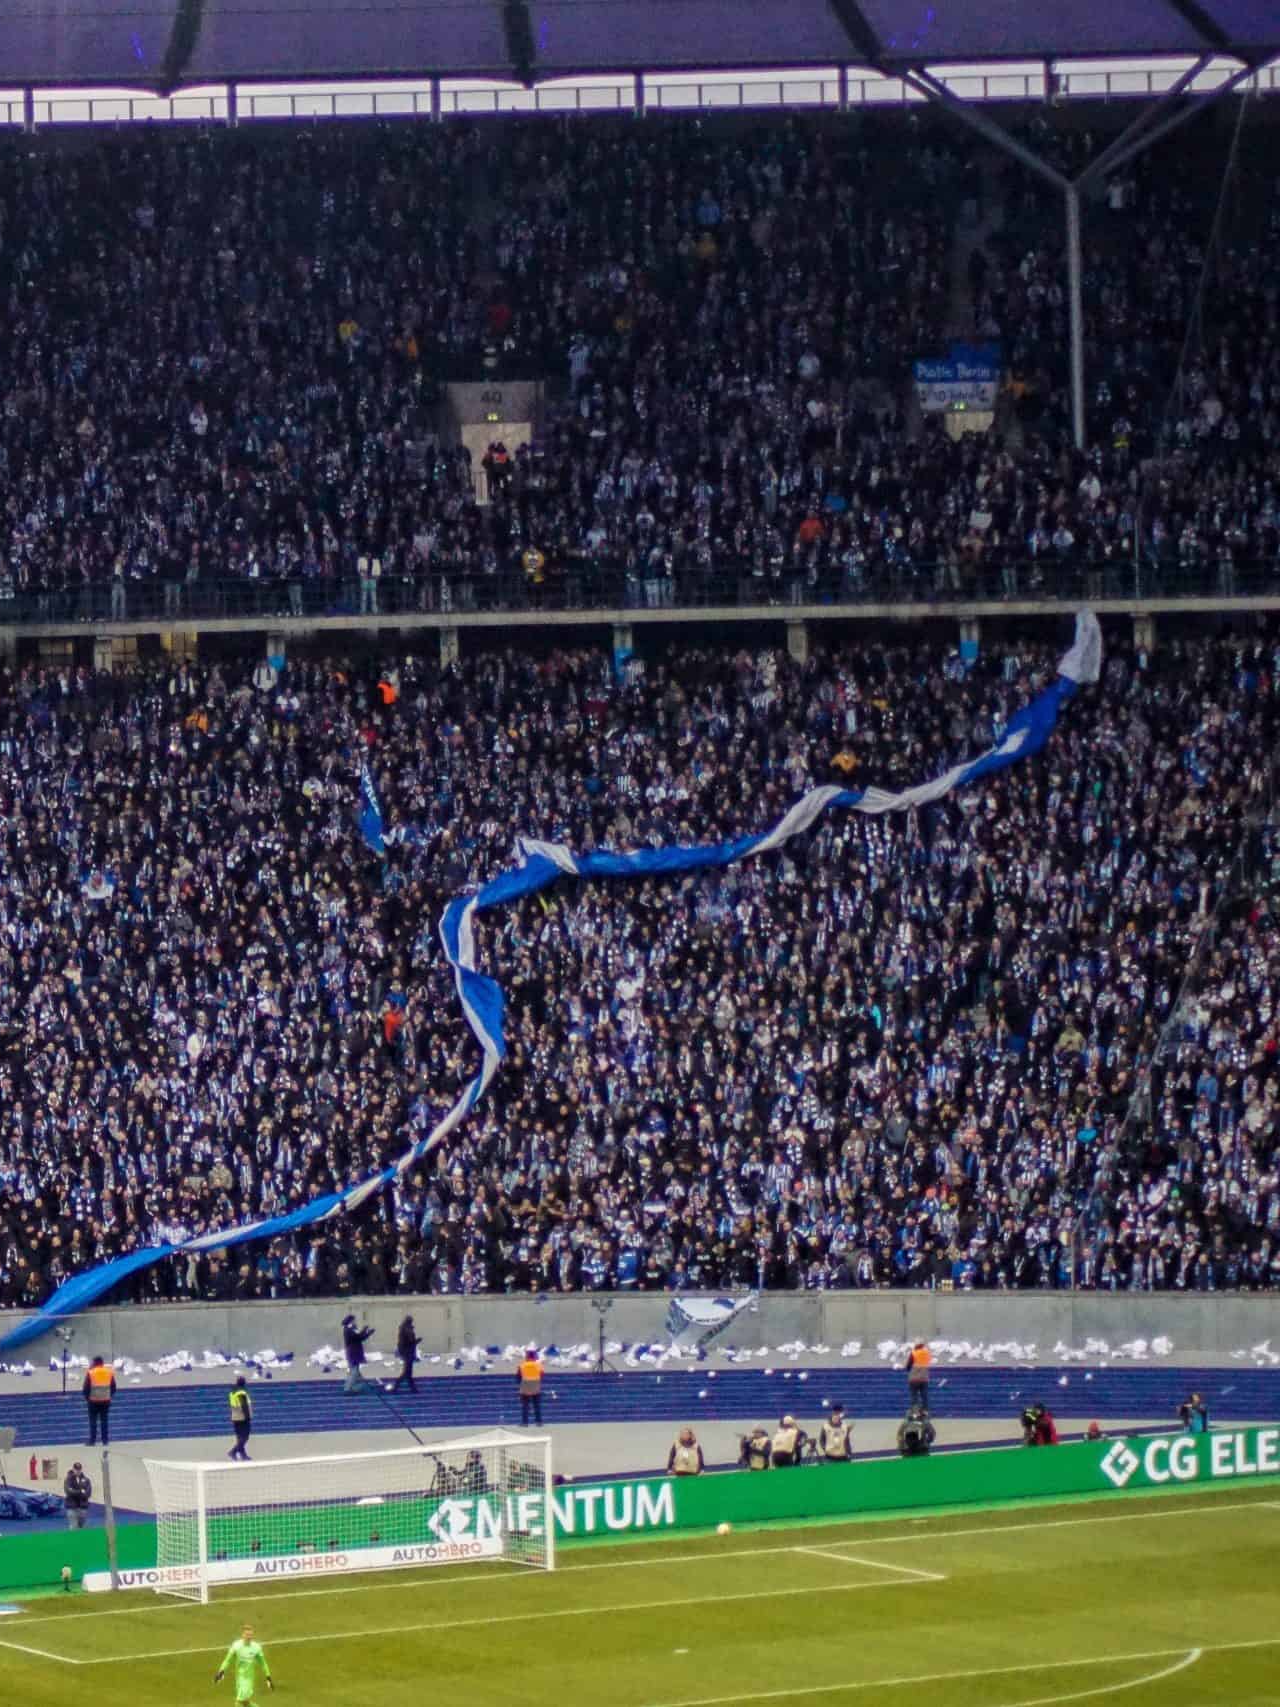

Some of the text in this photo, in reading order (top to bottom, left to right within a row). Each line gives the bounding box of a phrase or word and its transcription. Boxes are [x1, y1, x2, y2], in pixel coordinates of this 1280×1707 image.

[1144, 1429, 1280, 1482] CG ELE
[393, 1541, 482, 1561] AUTOHERO
[255, 1554, 347, 1573] AUTOHERO
